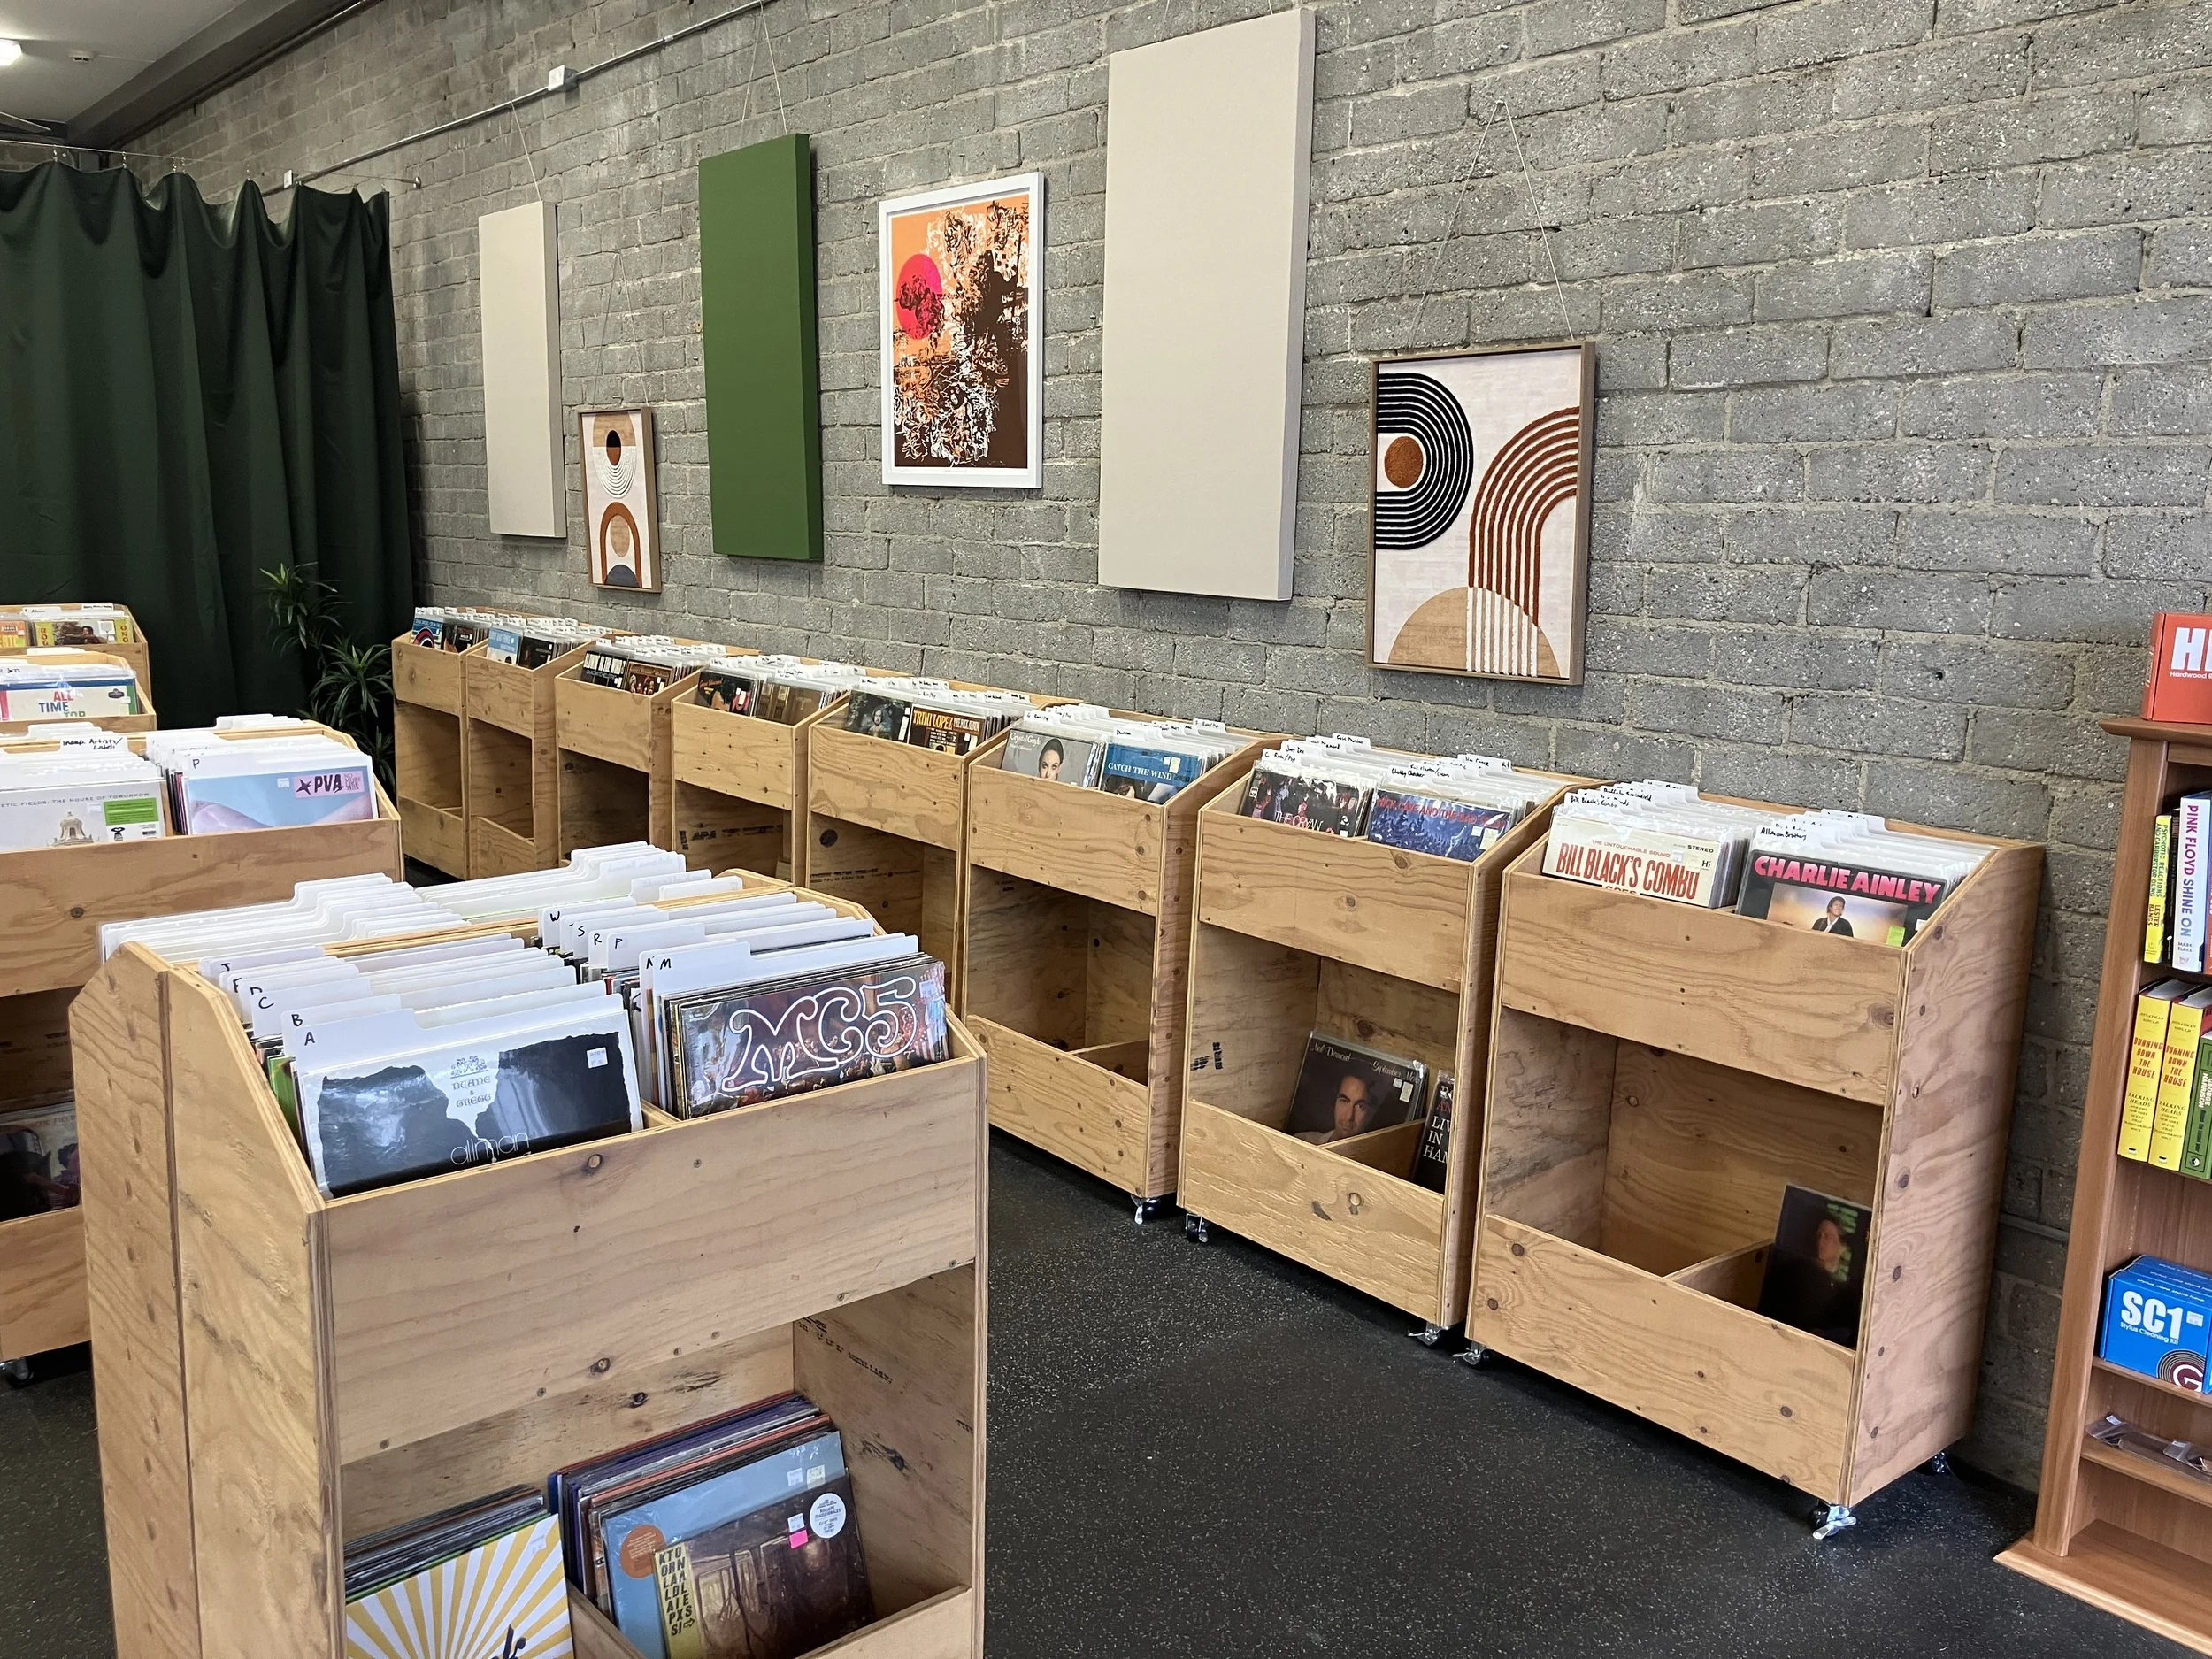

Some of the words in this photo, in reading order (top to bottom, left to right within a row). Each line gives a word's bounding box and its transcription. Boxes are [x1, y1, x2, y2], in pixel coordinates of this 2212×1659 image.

[2170, 627, 2212, 672] H
[2170, 671, 2207, 680] Hardwood
[53, 691, 73, 703] ALL
[39, 702, 69, 713] TIME
[913, 710, 933, 726] TRINI
[933, 713, 954, 730] LOPEZ
[1010, 732, 1027, 742] Crystal
[1026, 734, 1042, 747] Gayle
[193, 758, 200, 769] P
[1108, 763, 1132, 773] CATCH
[1133, 766, 1150, 776] THE
[1151, 771, 1172, 780] WIND
[314, 774, 343, 794] PVA
[1275, 810, 1293, 825] THE
[1420, 805, 1438, 818] AND
[1440, 809, 1457, 821] THE
[2186, 804, 2200, 833] PINK
[2160, 824, 2169, 859] PSYCHOTIC
[1604, 841, 1647, 855] UNTOUCHABLE
[1648, 849, 1671, 858] SOUND
[1687, 844, 1714, 854] STEREO
[2184, 836, 2197, 876] FLOYD
[1555, 842, 1585, 877] BILL
[1583, 848, 1642, 888] BLACK'S
[1701, 859, 1712, 869] Hi
[1755, 855, 1852, 890] CHARLIE
[1850, 872, 1942, 904] AINLEY
[2156, 862, 2165, 898] REACTIONS
[2181, 879, 2194, 915] SHINE
[550, 910, 560, 922] W
[578, 926, 585, 937] S
[2180, 918, 2193, 937] ON
[594, 933, 603, 946] R
[615, 938, 623, 949] P
[659, 958, 672, 970] M
[233, 977, 242, 993] F
[258, 996, 274, 1009] C
[291, 1014, 303, 1027] B
[304, 1032, 315, 1046] A
[721, 976, 918, 1093] MC5
[2134, 1037, 2163, 1050] BURNING
[2137, 1048, 2156, 1059] DOWN
[2165, 1045, 2195, 1059] BURNING
[2139, 1059, 2151, 1068] THE
[2168, 1056, 2188, 1068] DOWN
[2132, 1066, 2155, 1079] HOUSE
[2170, 1067, 2183, 1077] THE
[2163, 1074, 2187, 1087] HOUSE
[2128, 1092, 2155, 1102] TALKING
[2198, 1072, 2209, 1109] HARRISON
[456, 1093, 492, 1108] GREGG
[2159, 1101, 2186, 1111] TALKING
[1427, 1130, 1444, 1146] IN
[450, 1132, 530, 1165] allman
[2121, 1290, 2183, 1340] SC1
[2120, 1321, 2139, 1333] Stylus
[2139, 1328, 2169, 1343] Cleaning
